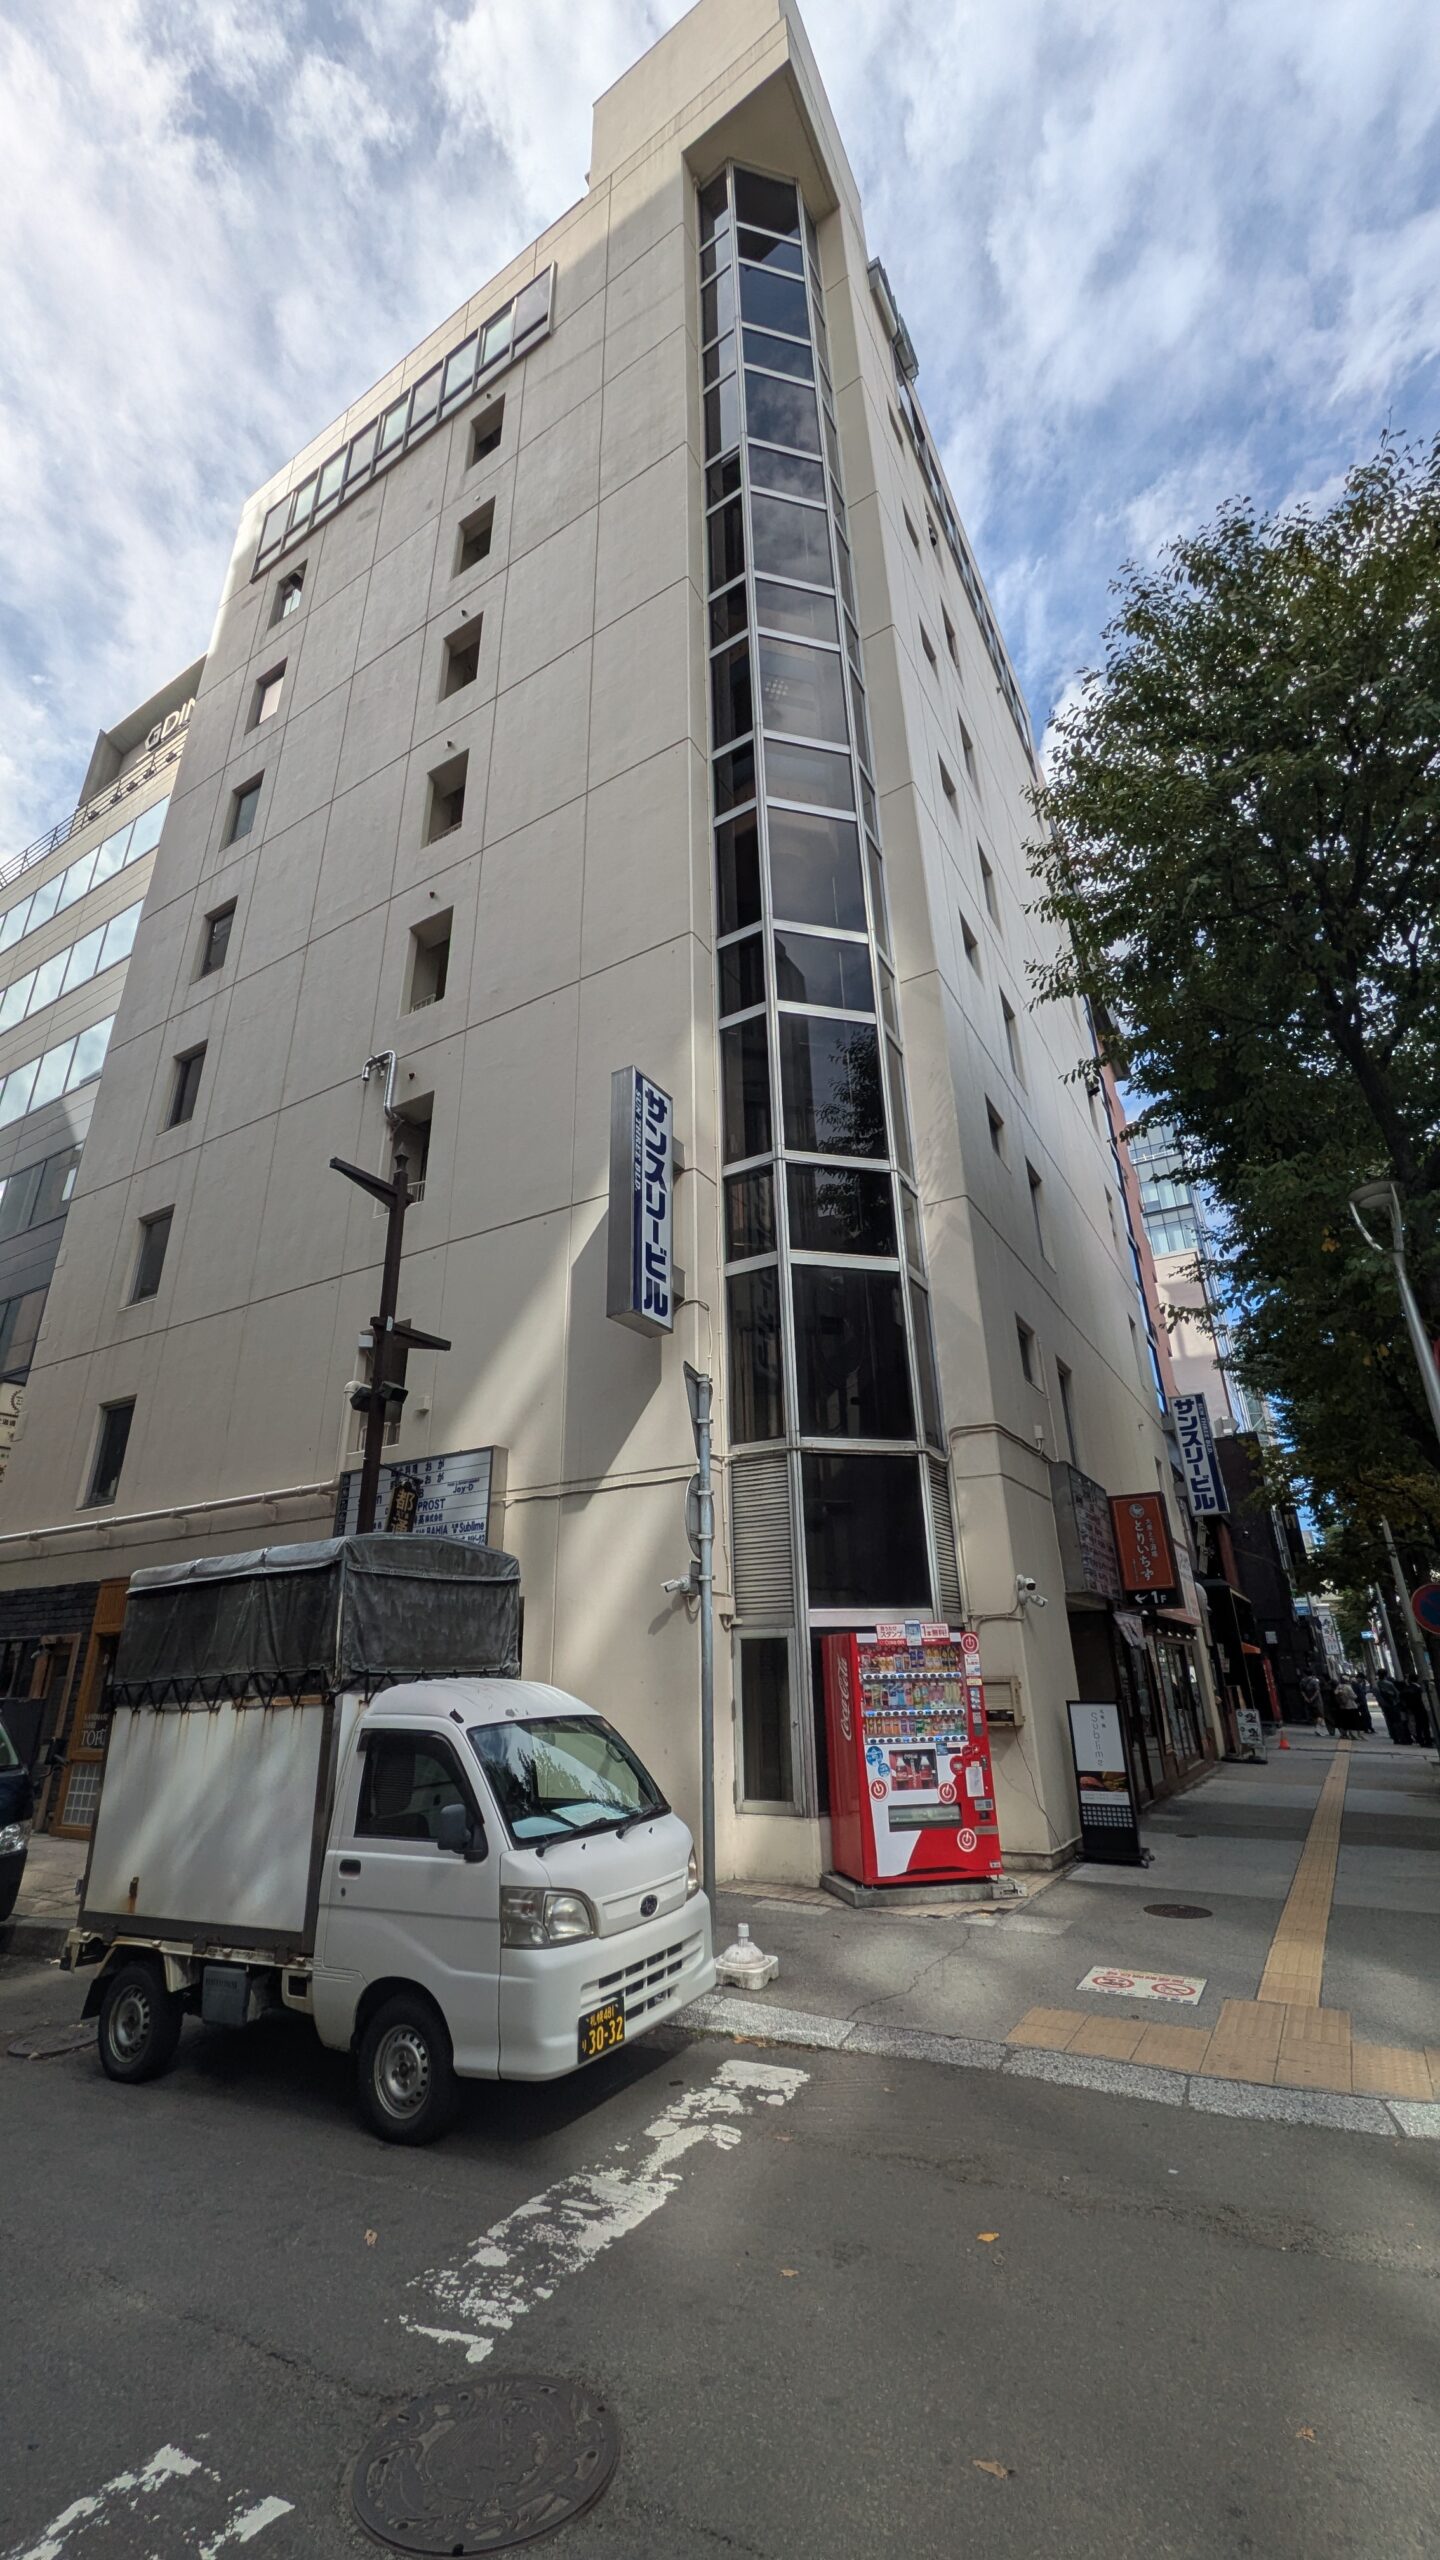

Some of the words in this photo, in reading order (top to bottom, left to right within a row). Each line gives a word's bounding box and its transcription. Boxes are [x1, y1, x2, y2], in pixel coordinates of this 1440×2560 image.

[644, 1087, 668, 1317] サンスリービル
[1174, 1399, 1214, 1511] サンスリービル
[417, 1498, 446, 1512] PROST
[459, 1521, 485, 1533] Sublime
[1150, 1590, 1167, 1604] 1F
[589, 2016, 623, 2054] 30-32
